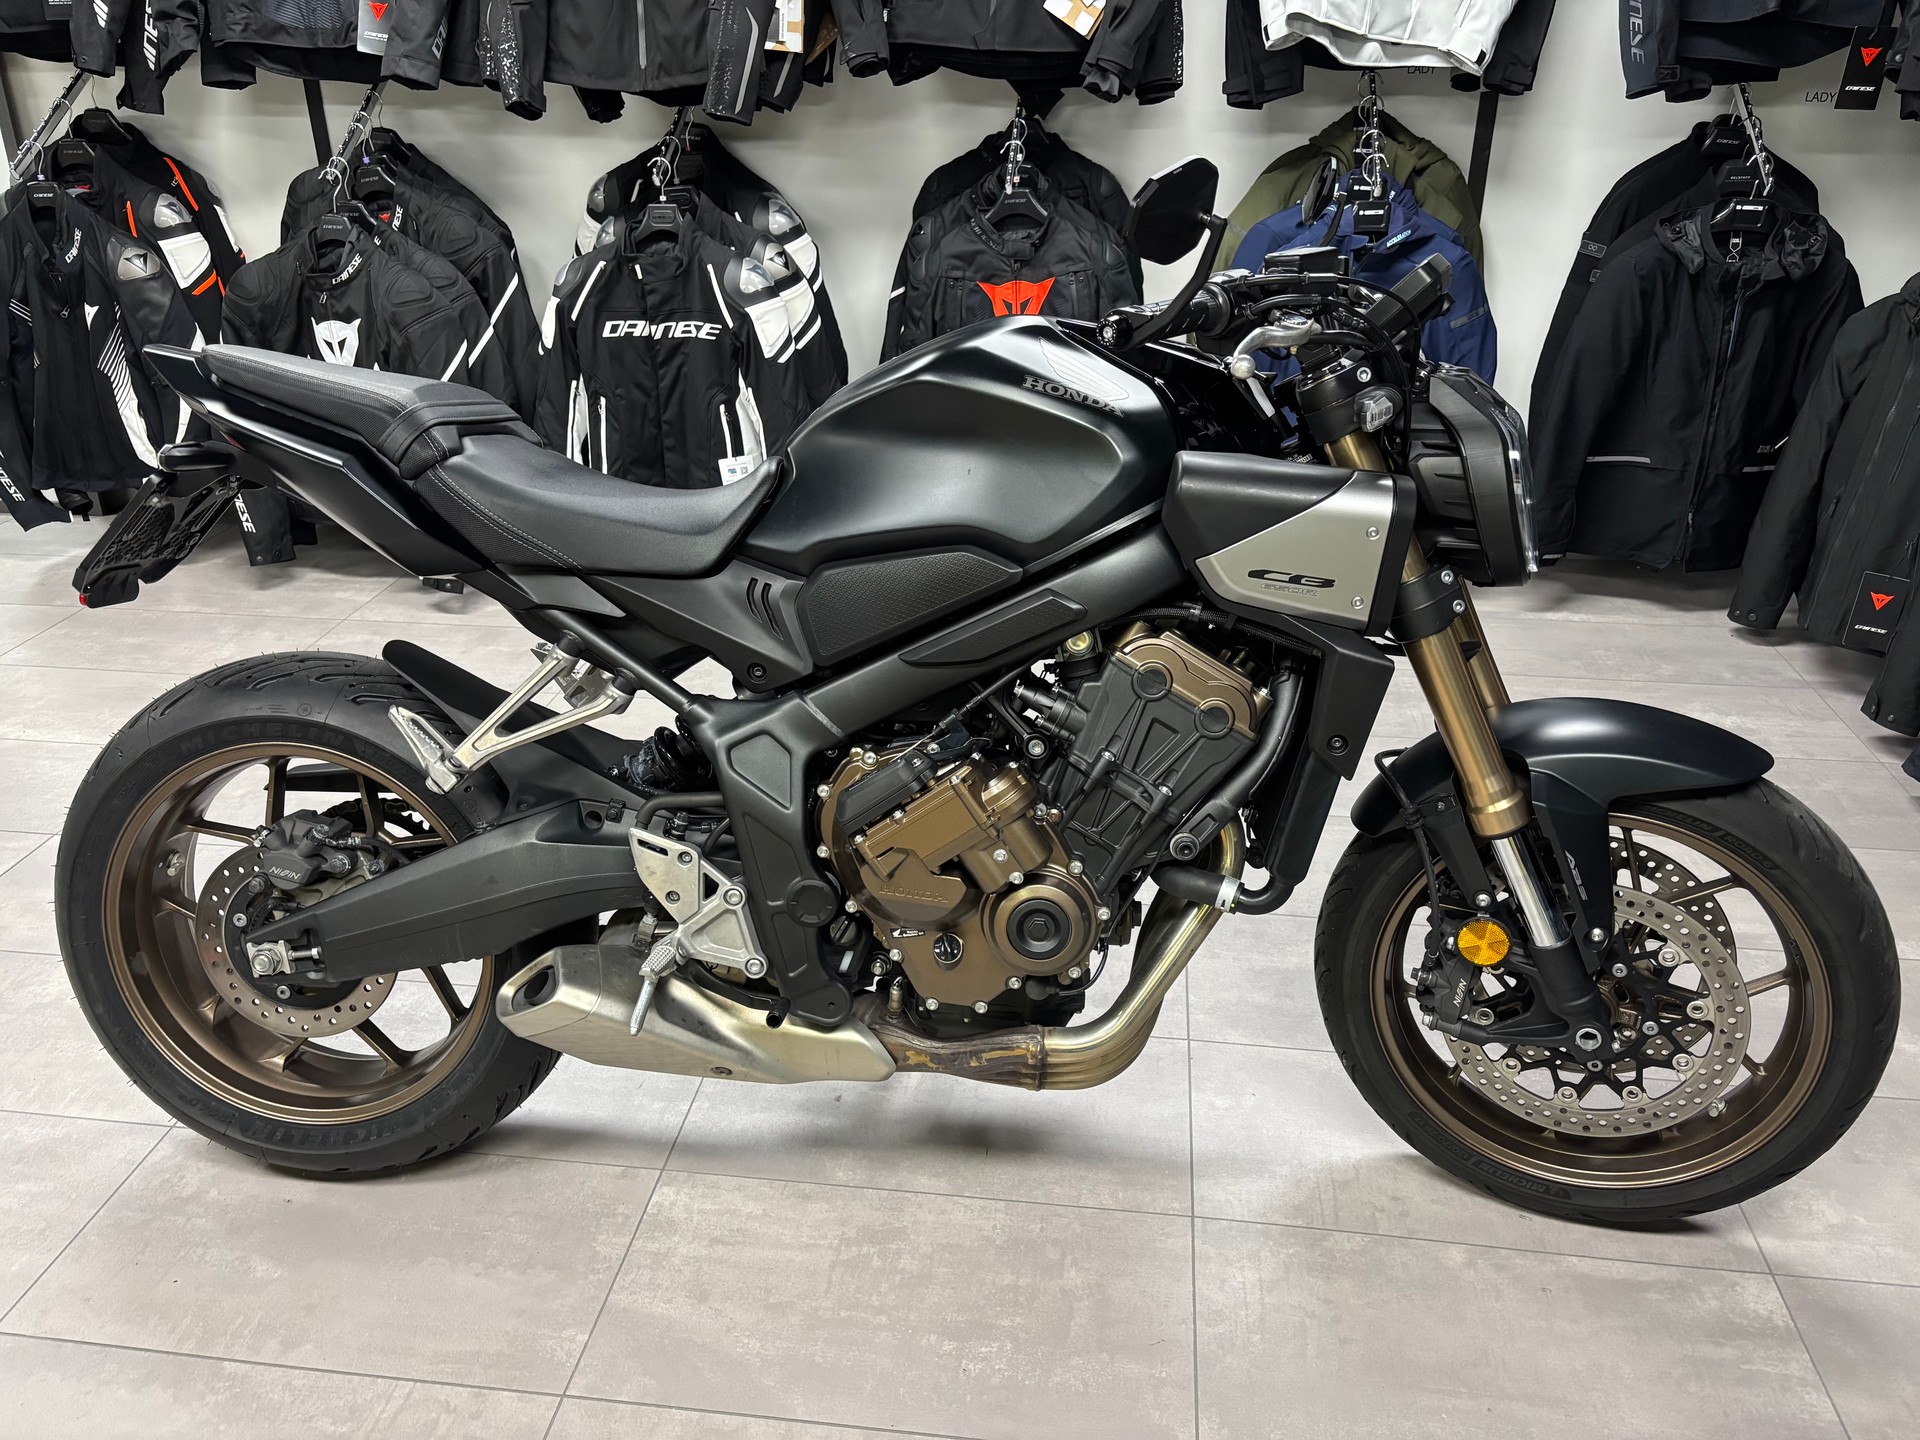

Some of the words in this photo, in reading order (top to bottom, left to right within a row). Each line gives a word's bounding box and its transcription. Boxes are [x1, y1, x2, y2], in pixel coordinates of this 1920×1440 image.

[1805, 91, 1838, 103] LADY
[64, 226, 83, 264] DAINESE
[331, 252, 363, 285] DAINESE
[1022, 376, 1125, 418] HONDA
[1247, 569, 1336, 589] CB
[1854, 624, 1889, 635] DAINESE
[1477, 1162, 1547, 1193] MICHELIN
